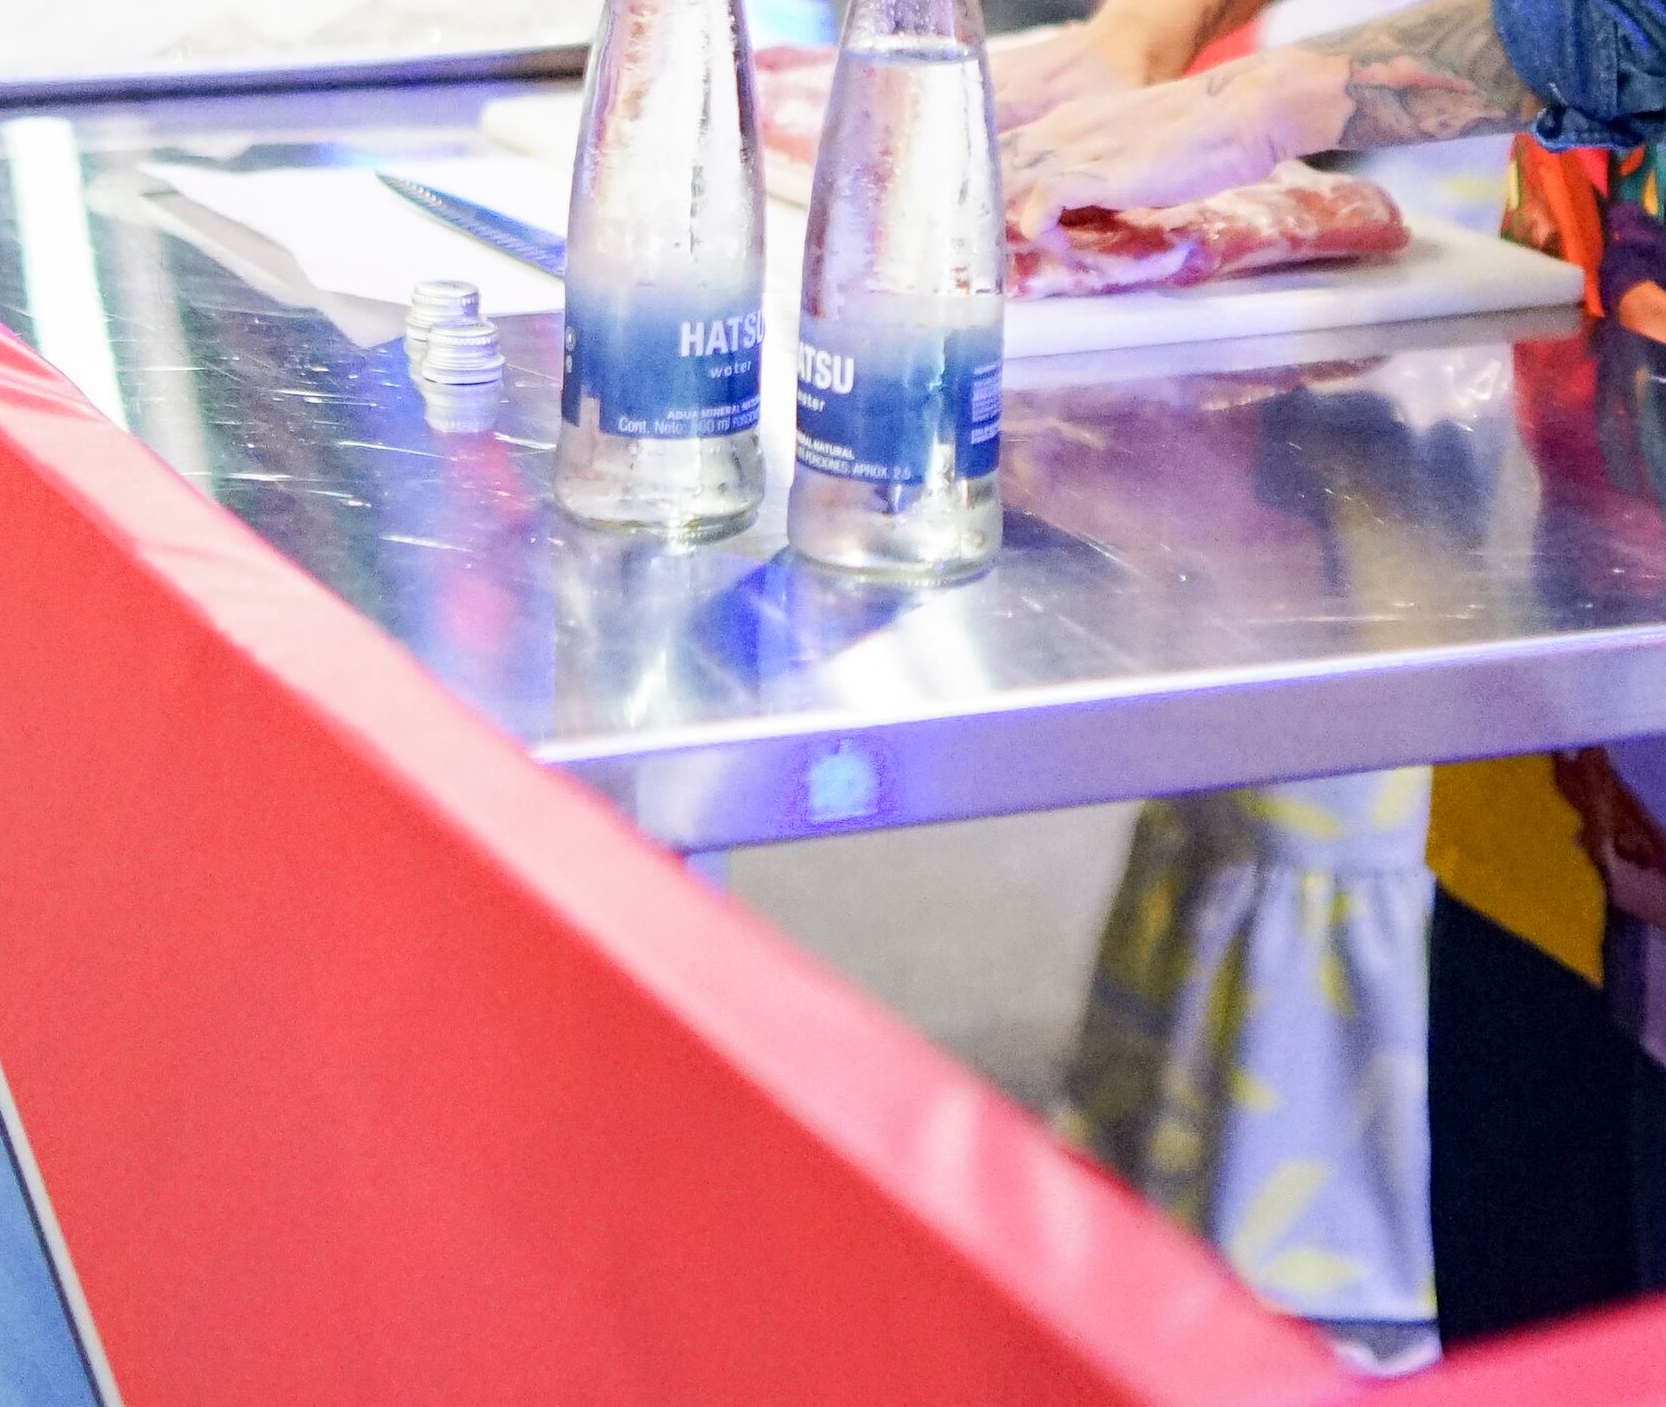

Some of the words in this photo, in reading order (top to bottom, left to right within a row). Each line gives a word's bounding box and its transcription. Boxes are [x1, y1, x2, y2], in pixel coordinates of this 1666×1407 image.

[681, 311, 764, 358] HATSU
[709, 360, 752, 379] water
[798, 342, 855, 395] ATSU
